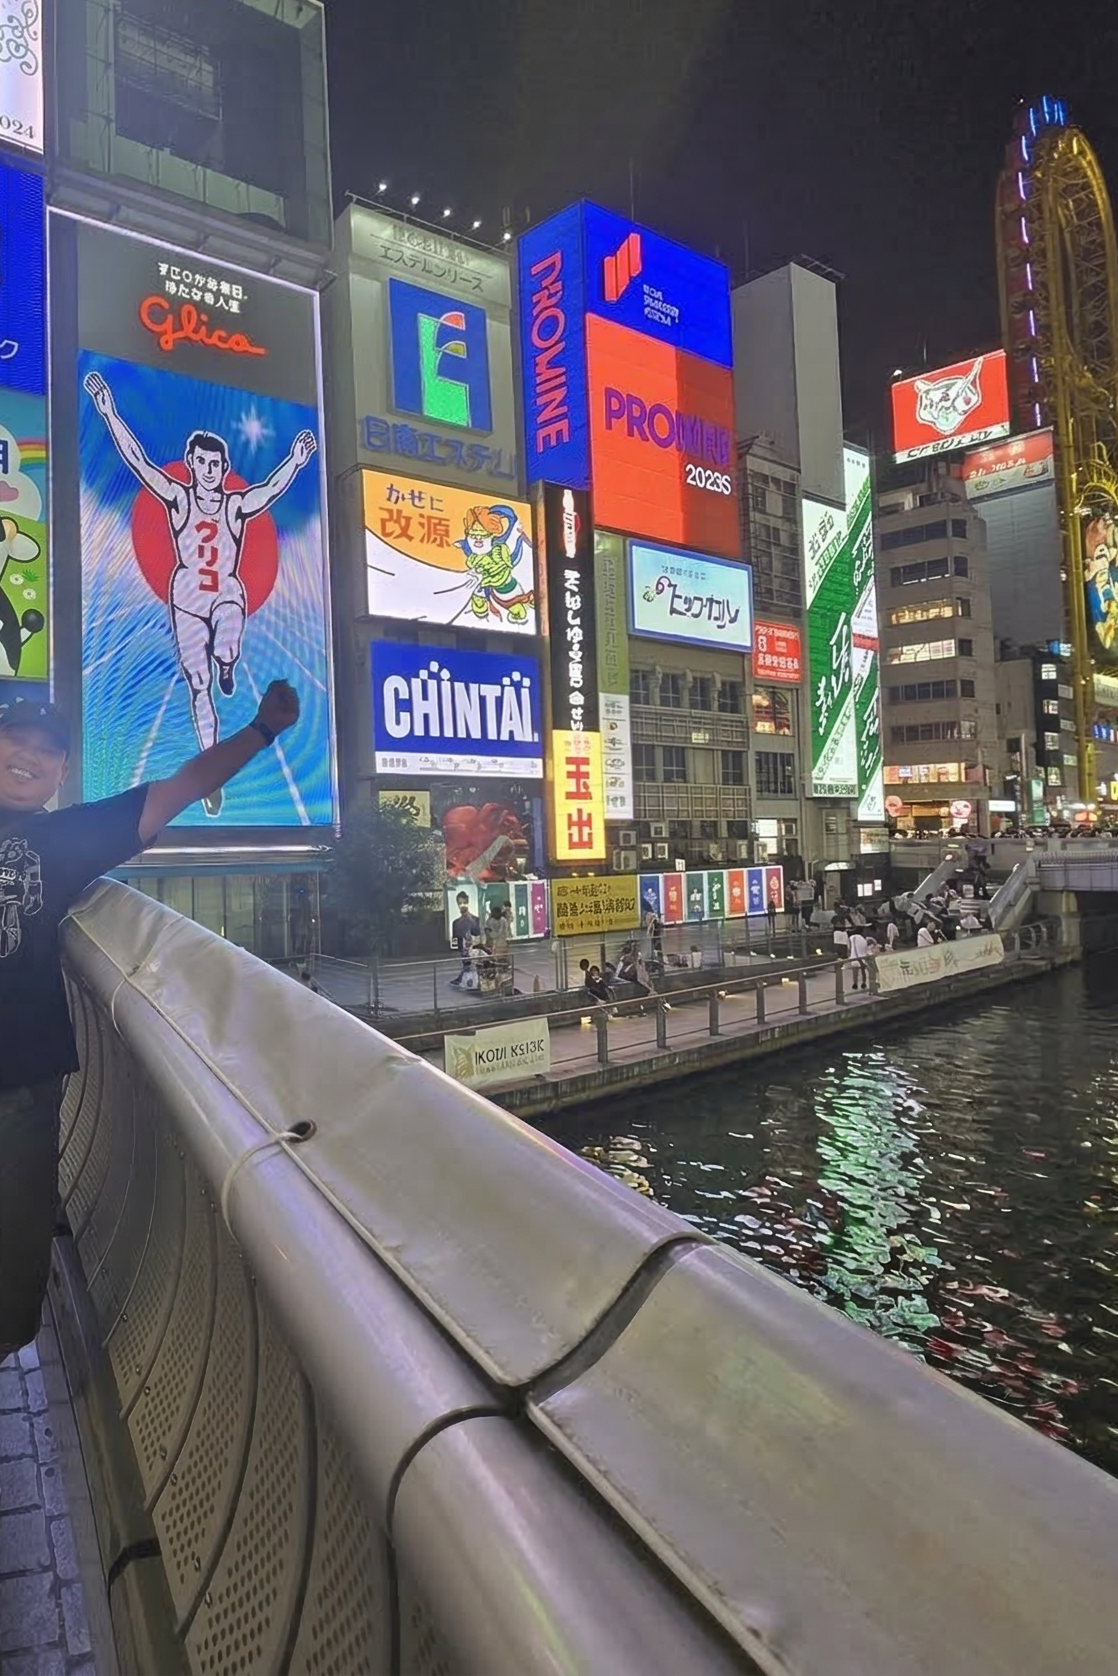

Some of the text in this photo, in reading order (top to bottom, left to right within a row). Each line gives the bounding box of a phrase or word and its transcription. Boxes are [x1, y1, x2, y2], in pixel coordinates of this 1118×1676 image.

[139, 294, 267, 355] Glico
[378, 506, 452, 549] 改源
[565, 756, 593, 850] 玉出
